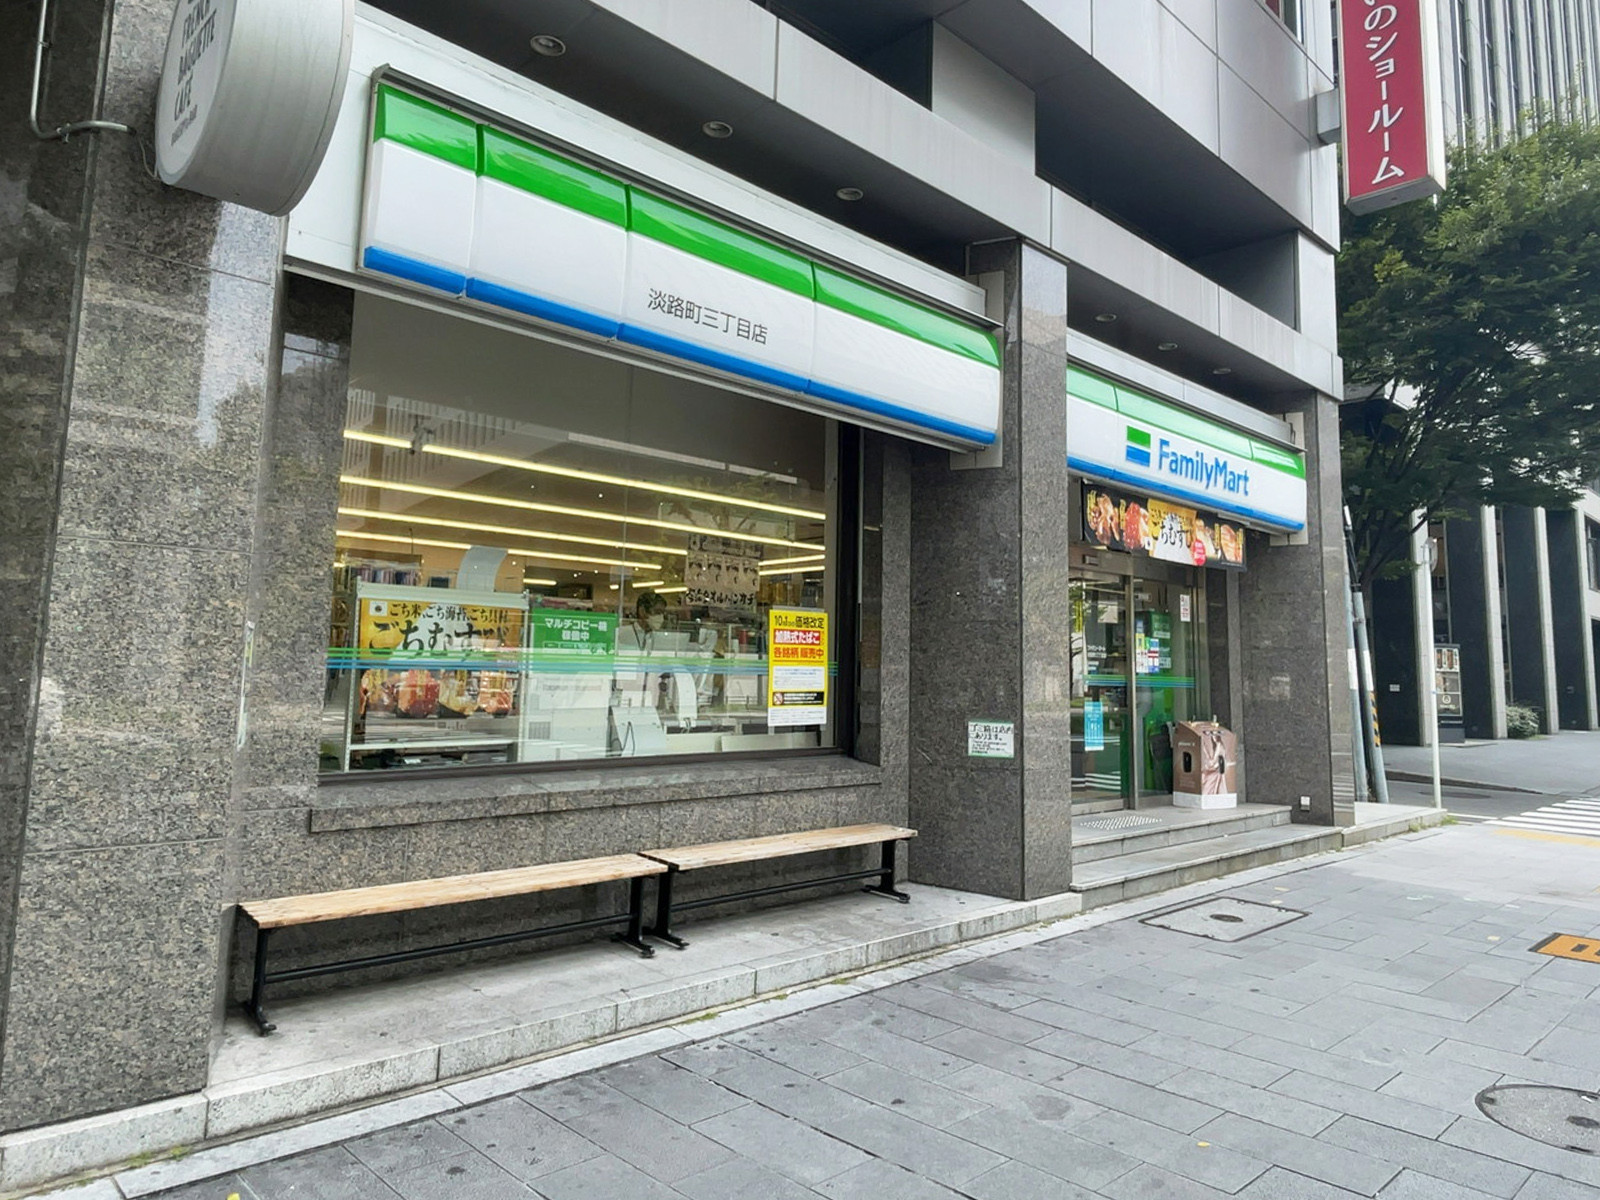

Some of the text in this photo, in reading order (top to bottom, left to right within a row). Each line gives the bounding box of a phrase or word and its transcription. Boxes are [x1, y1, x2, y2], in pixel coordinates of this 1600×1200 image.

[1363, 0, 1405, 184] のショールーム
[647, 287, 769, 345] 淡路町三丁目店
[1158, 437, 1250, 497] FamilyMart
